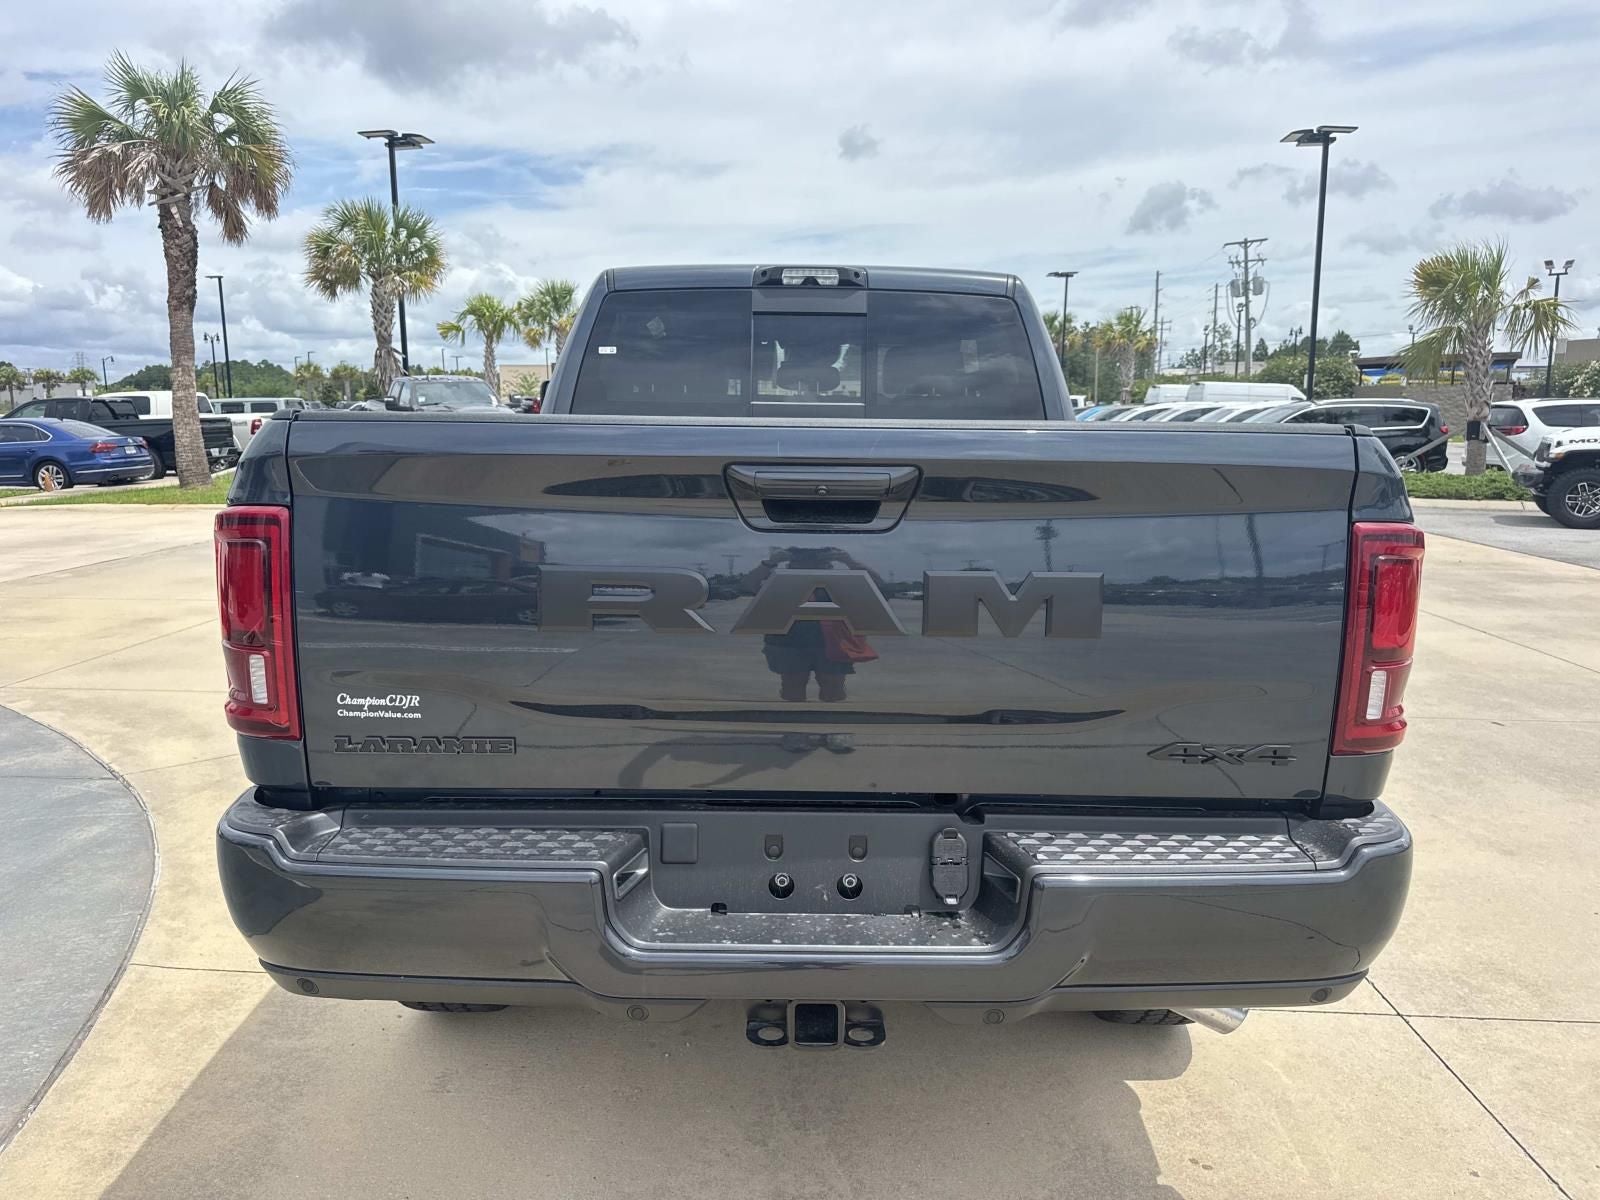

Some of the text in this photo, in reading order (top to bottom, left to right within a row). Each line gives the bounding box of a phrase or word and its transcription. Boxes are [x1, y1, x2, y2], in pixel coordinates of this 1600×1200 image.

[537, 564, 1105, 638] RAM
[336, 692, 420, 710] ChampionCDJR
[336, 709, 422, 719] ChampionValue.com
[333, 735, 517, 755] LARAMIE
